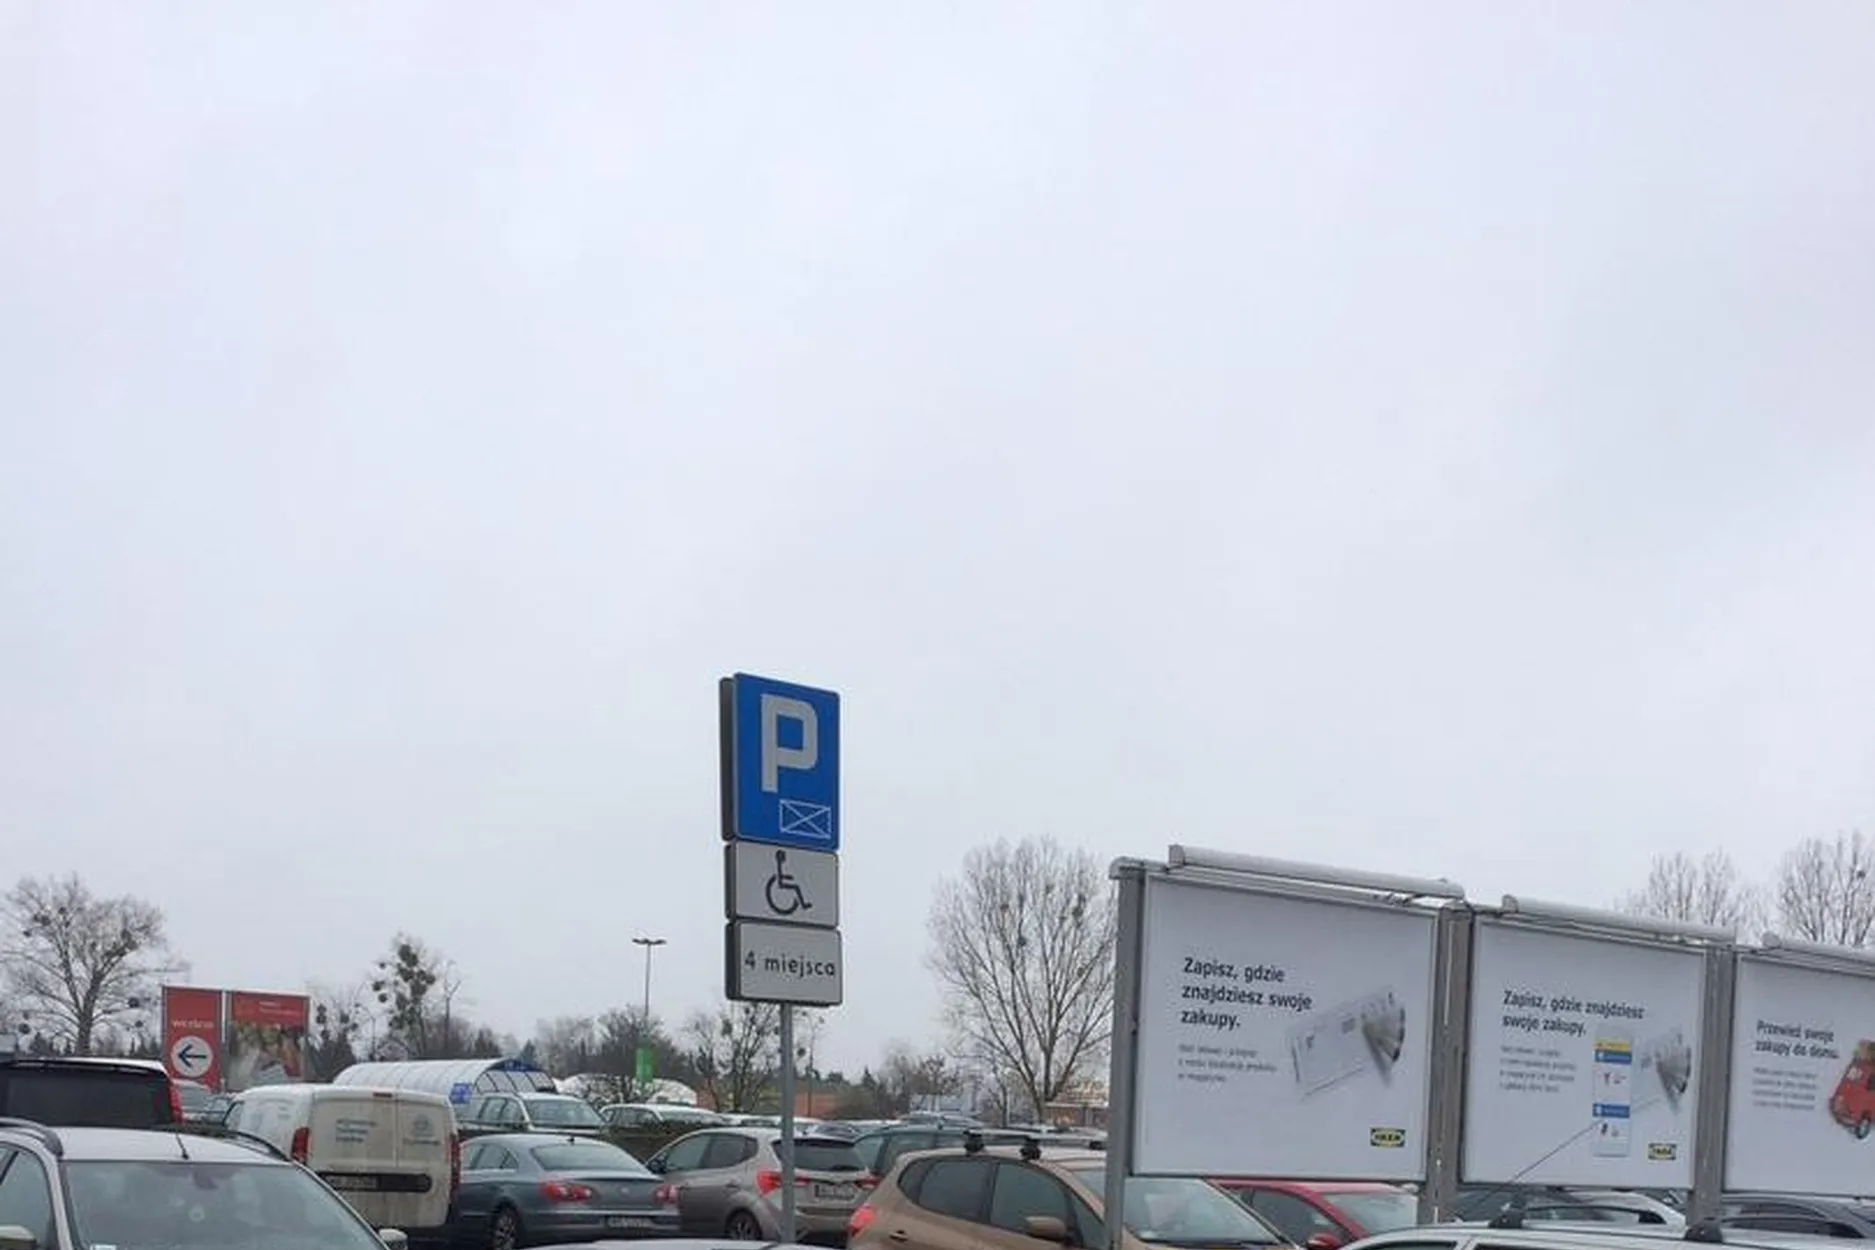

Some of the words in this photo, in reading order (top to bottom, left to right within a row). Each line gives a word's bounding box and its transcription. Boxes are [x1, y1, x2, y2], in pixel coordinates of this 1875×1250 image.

[761, 693, 819, 793] P
[744, 950, 756, 971] 4
[764, 953, 835, 978] miejsca
[1183, 956, 1239, 980] Zapisz,
[1244, 964, 1285, 983] gdzie
[1181, 984, 1263, 1005] znajdziesz
[1268, 993, 1313, 1013] swoje
[1180, 1009, 1241, 1031] zakupy.
